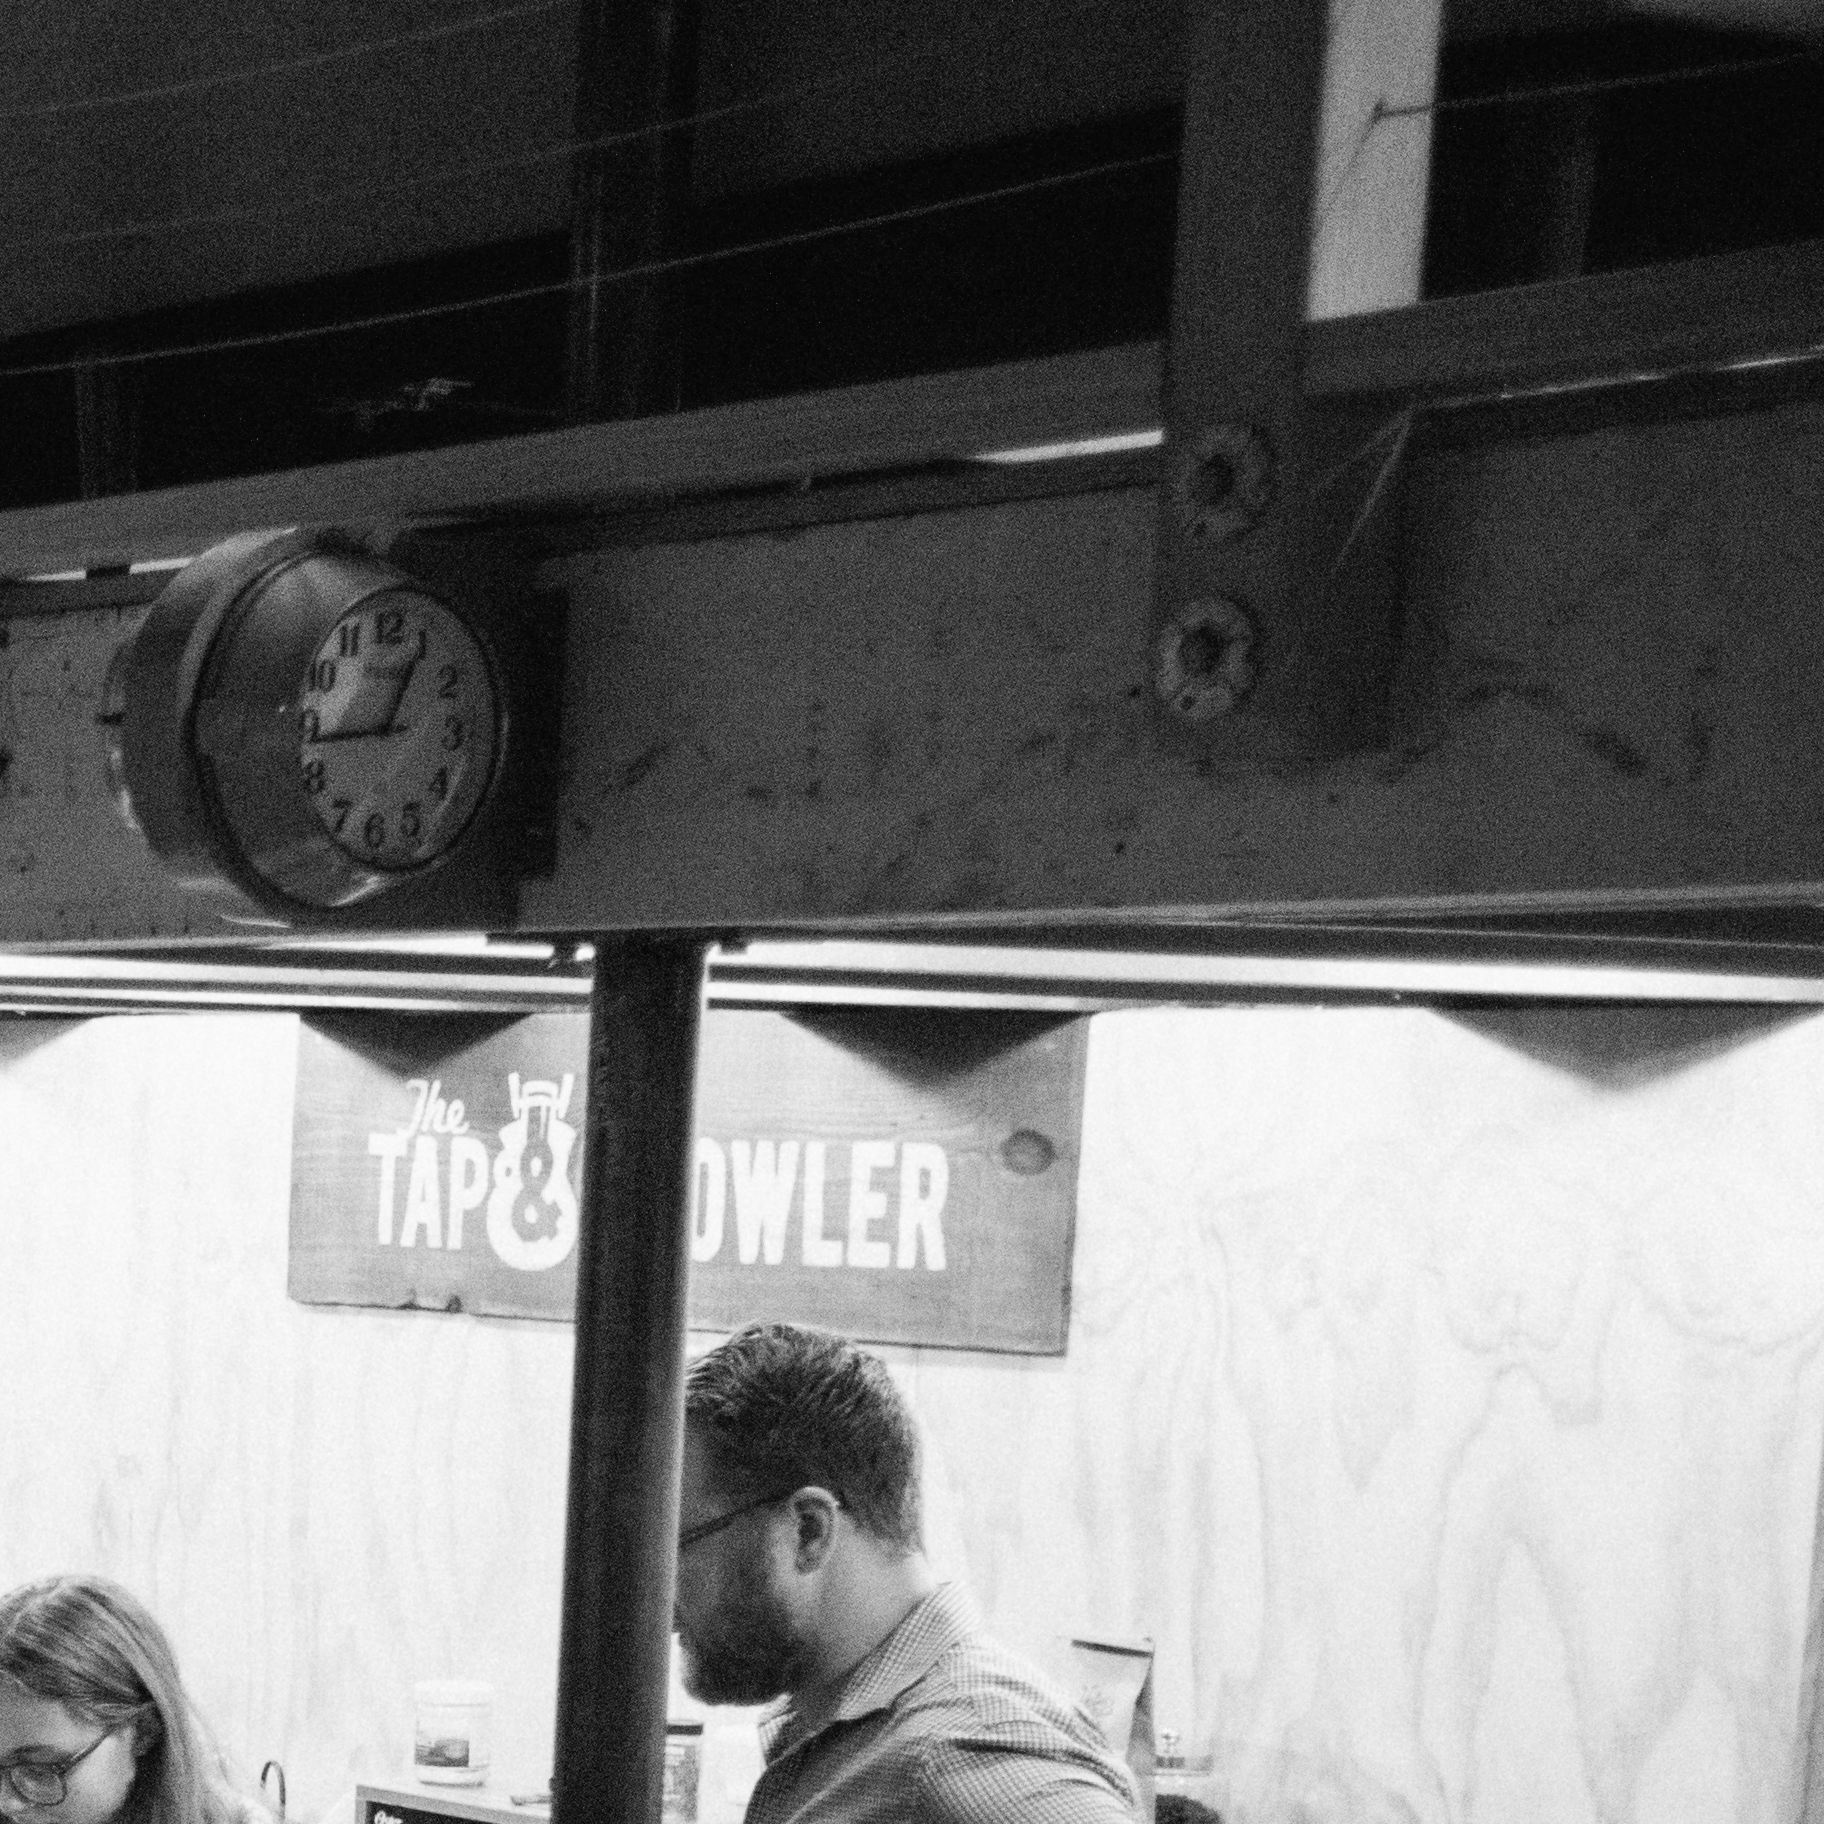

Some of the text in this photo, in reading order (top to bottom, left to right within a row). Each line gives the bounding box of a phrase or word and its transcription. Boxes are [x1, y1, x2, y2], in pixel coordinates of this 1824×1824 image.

[339, 623, 361, 657] 11
[374, 609, 406, 645] 12
[438, 664, 459, 700] 2
[443, 715, 464, 751] 3
[303, 759, 326, 794] 8
[428, 766, 449, 799] 4
[332, 800, 351, 835] 7
[363, 812, 385, 849] 6
[400, 801, 421, 839] 5
[396, 1079, 470, 1139] The
[368, 1131, 489, 1250] TAP
[689, 1137, 950, 1272] OWLER
